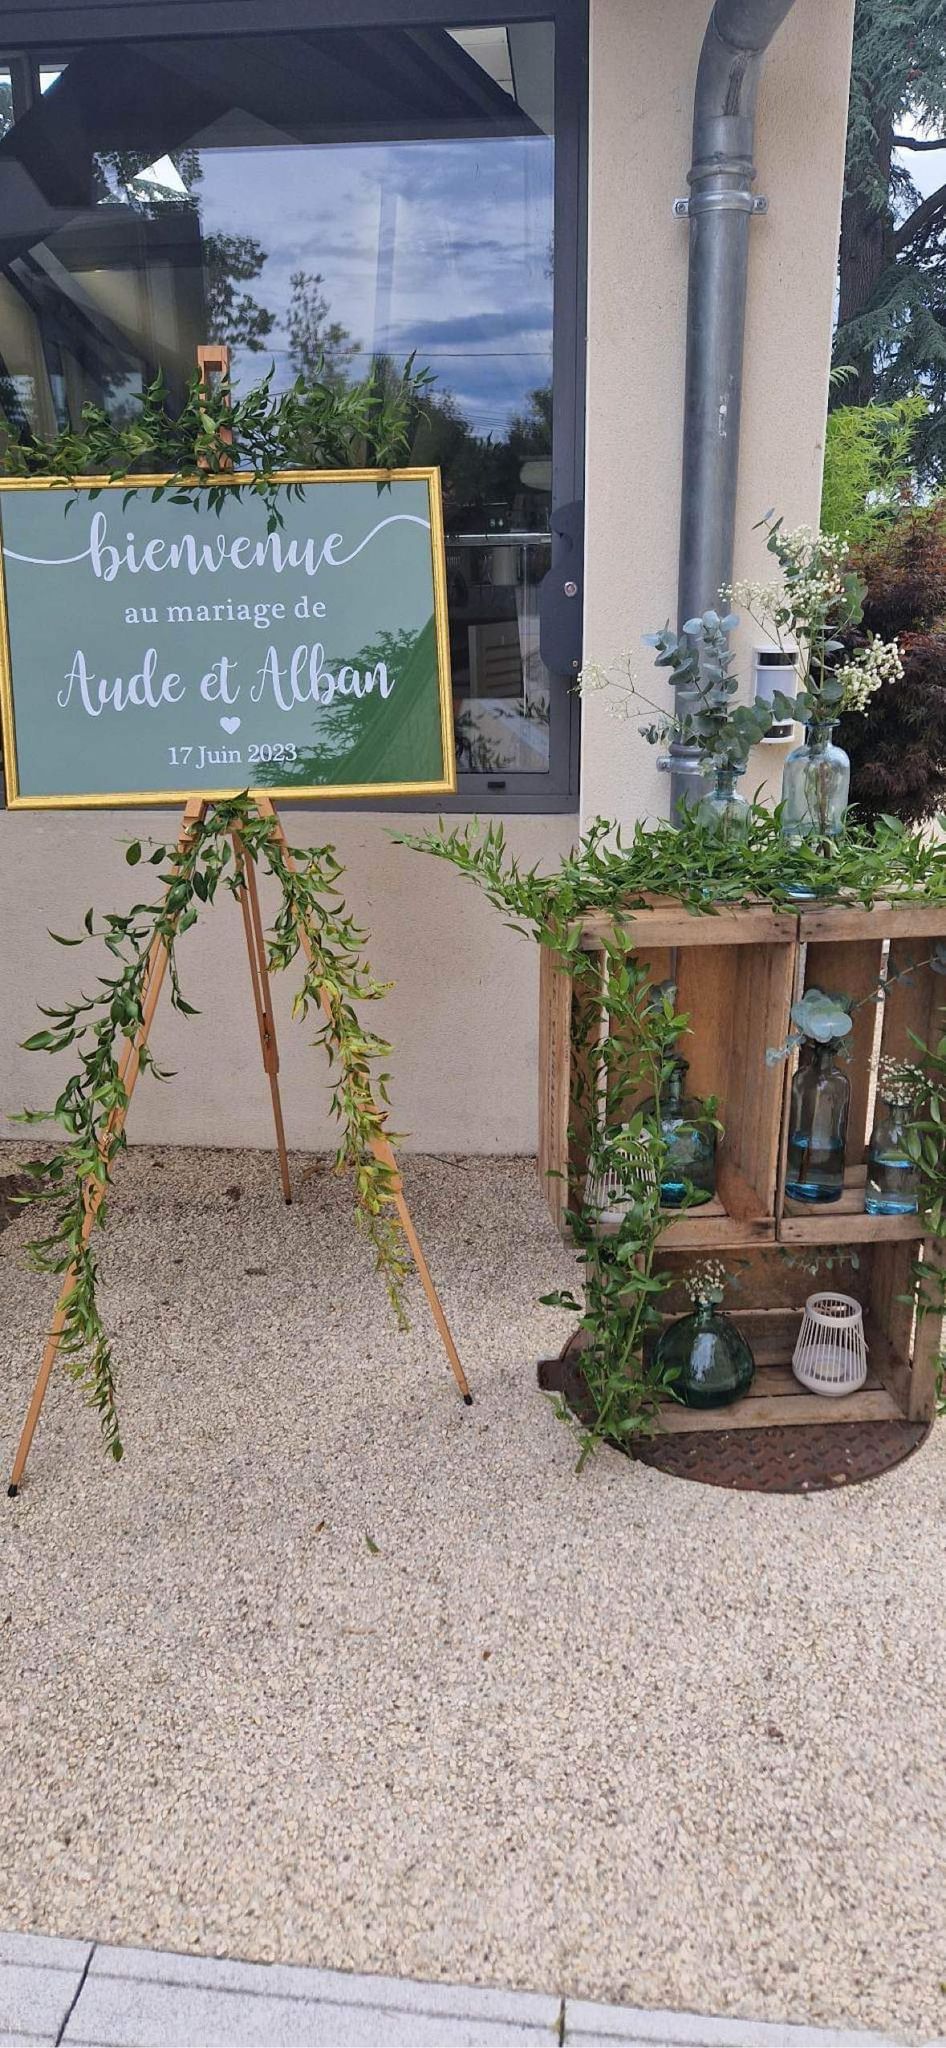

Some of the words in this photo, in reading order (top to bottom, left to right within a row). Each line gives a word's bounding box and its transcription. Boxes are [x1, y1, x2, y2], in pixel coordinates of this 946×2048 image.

[90, 511, 345, 581] bienvenue
[124, 605, 158, 624] au
[167, 599, 286, 628] mariage
[294, 596, 327, 619] de
[57, 648, 186, 717] Aude
[200, 656, 241, 705] et
[250, 643, 396, 711] Alban
[168, 746, 192, 765] 17
[195, 745, 241, 769] Juin
[248, 743, 298, 763] 2023
